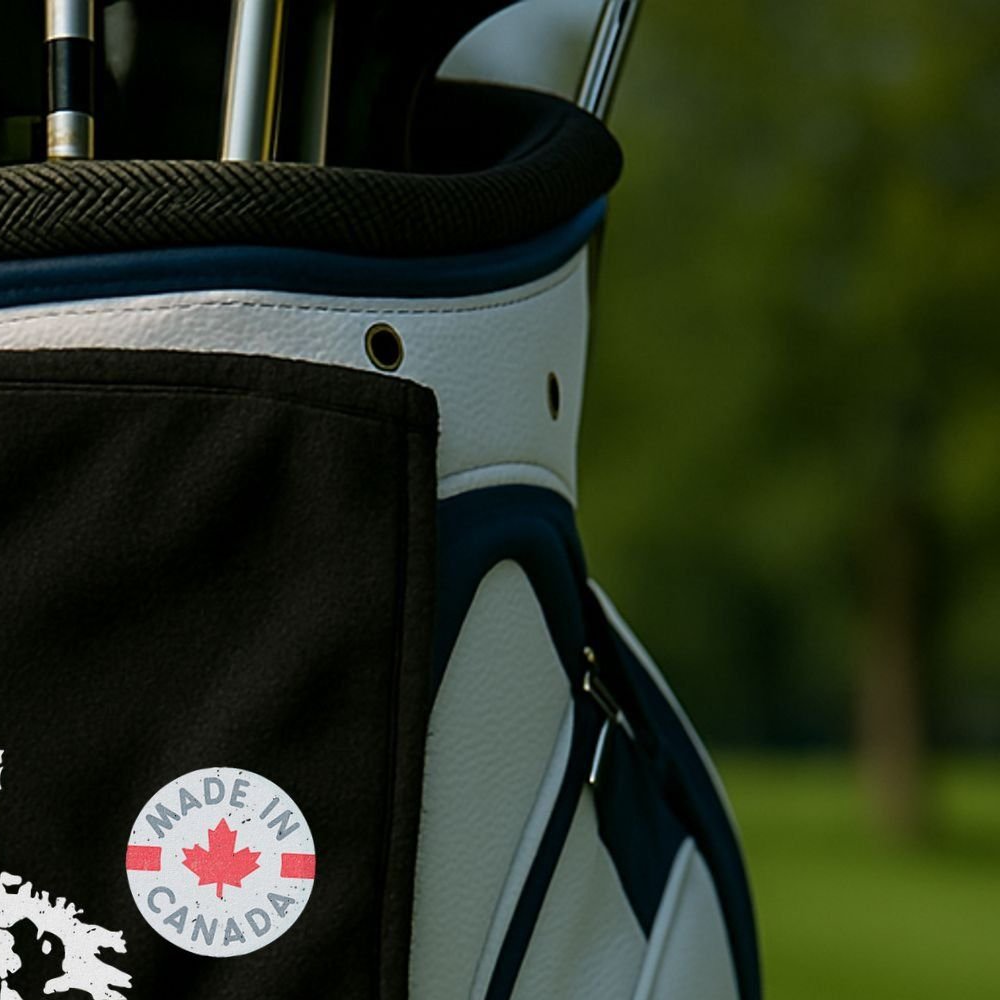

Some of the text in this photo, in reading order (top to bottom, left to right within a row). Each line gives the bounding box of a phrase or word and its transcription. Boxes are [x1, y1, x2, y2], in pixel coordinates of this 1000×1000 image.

[145, 777, 300, 841] MADE IN
[147, 886, 296, 946] CANADA
